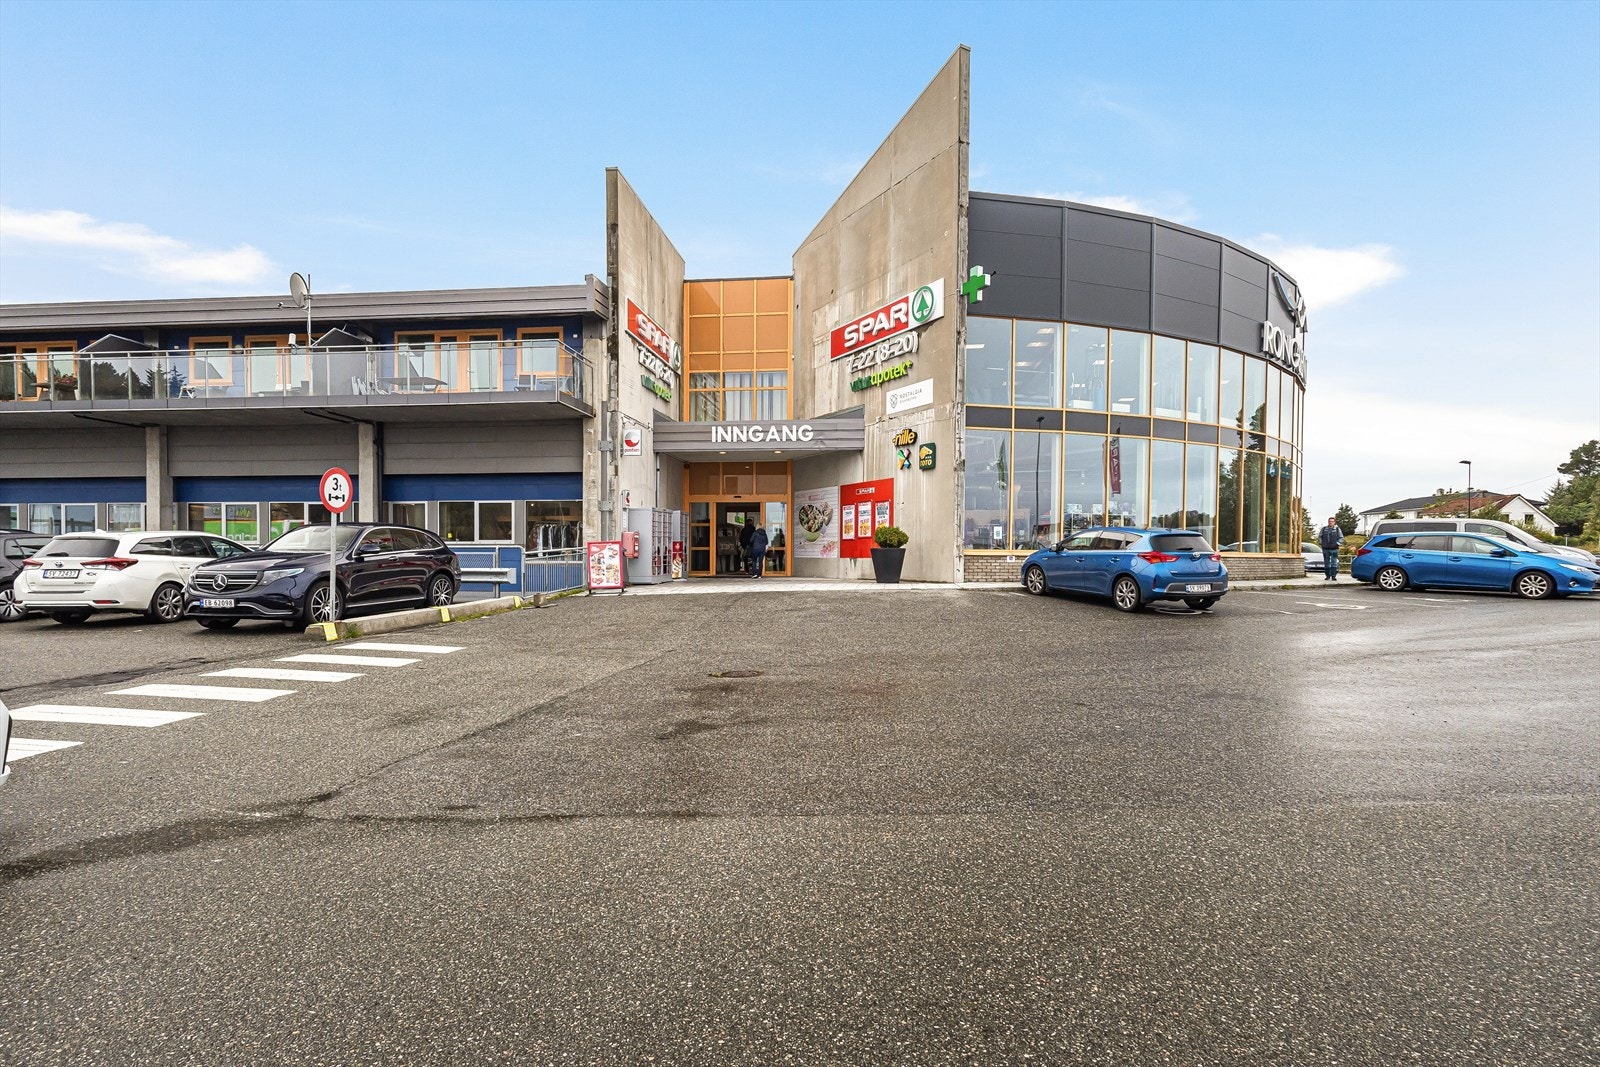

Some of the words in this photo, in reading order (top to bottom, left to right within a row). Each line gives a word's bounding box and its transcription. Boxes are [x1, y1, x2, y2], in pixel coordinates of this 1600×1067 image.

[844, 302, 908, 348] SPAR
[711, 424, 814, 443] INNGANG
[47, 569, 56, 577] SV
[58, 569, 77, 577] 72437
[214, 599, 233, 607] 62098
